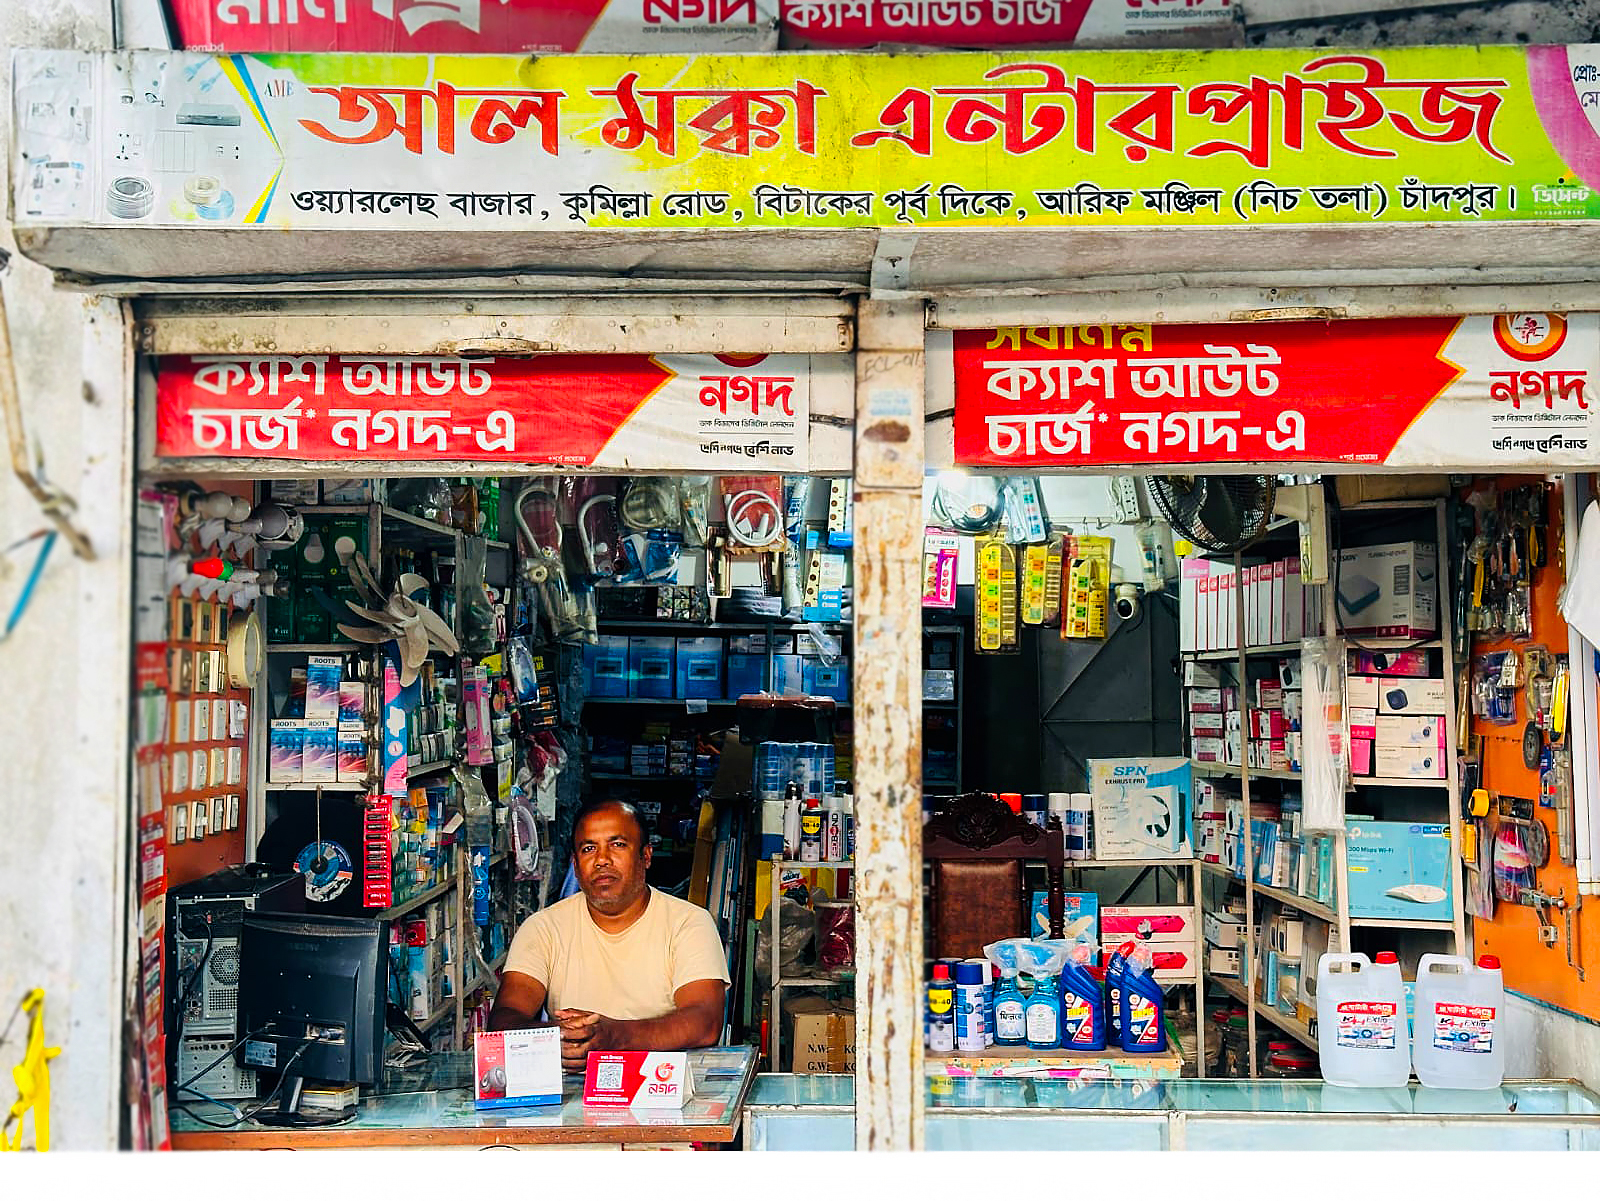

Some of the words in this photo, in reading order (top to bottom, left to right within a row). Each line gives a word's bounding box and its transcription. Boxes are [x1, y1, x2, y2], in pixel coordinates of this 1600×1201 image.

[264, 80, 294, 97] AME
[297, 81, 565, 156] আল
[590, 72, 827, 157] মক্কা
[852, 55, 1513, 168] এন্টারপ্রাইজ
[561, 184, 654, 222] কুমিল্লা
[755, 184, 872, 217] বিটাকের
[885, 183, 929, 223] পূর্ব
[1037, 181, 1132, 215] আরিফ
[1141, 181, 1223, 216] মঞ্জিল
[191, 355, 329, 396] ক্যাশ
[983, 359, 1118, 401] ক্যাশ
[1127, 344, 1281, 398] আউট
[1489, 371, 1588, 410] নগদ
[699, 375, 795, 416] নগদ
[328, 409, 515, 452] নগদ-এ
[743, 440, 769, 457] বেশি
[771, 446, 794, 455] লাভ
[1120, 410, 1305, 453] নগদ-এ
[1536, 434, 1562, 453] বেশি
[1564, 439, 1588, 449] লাভ
[1113, 766, 1148, 776] SPN
